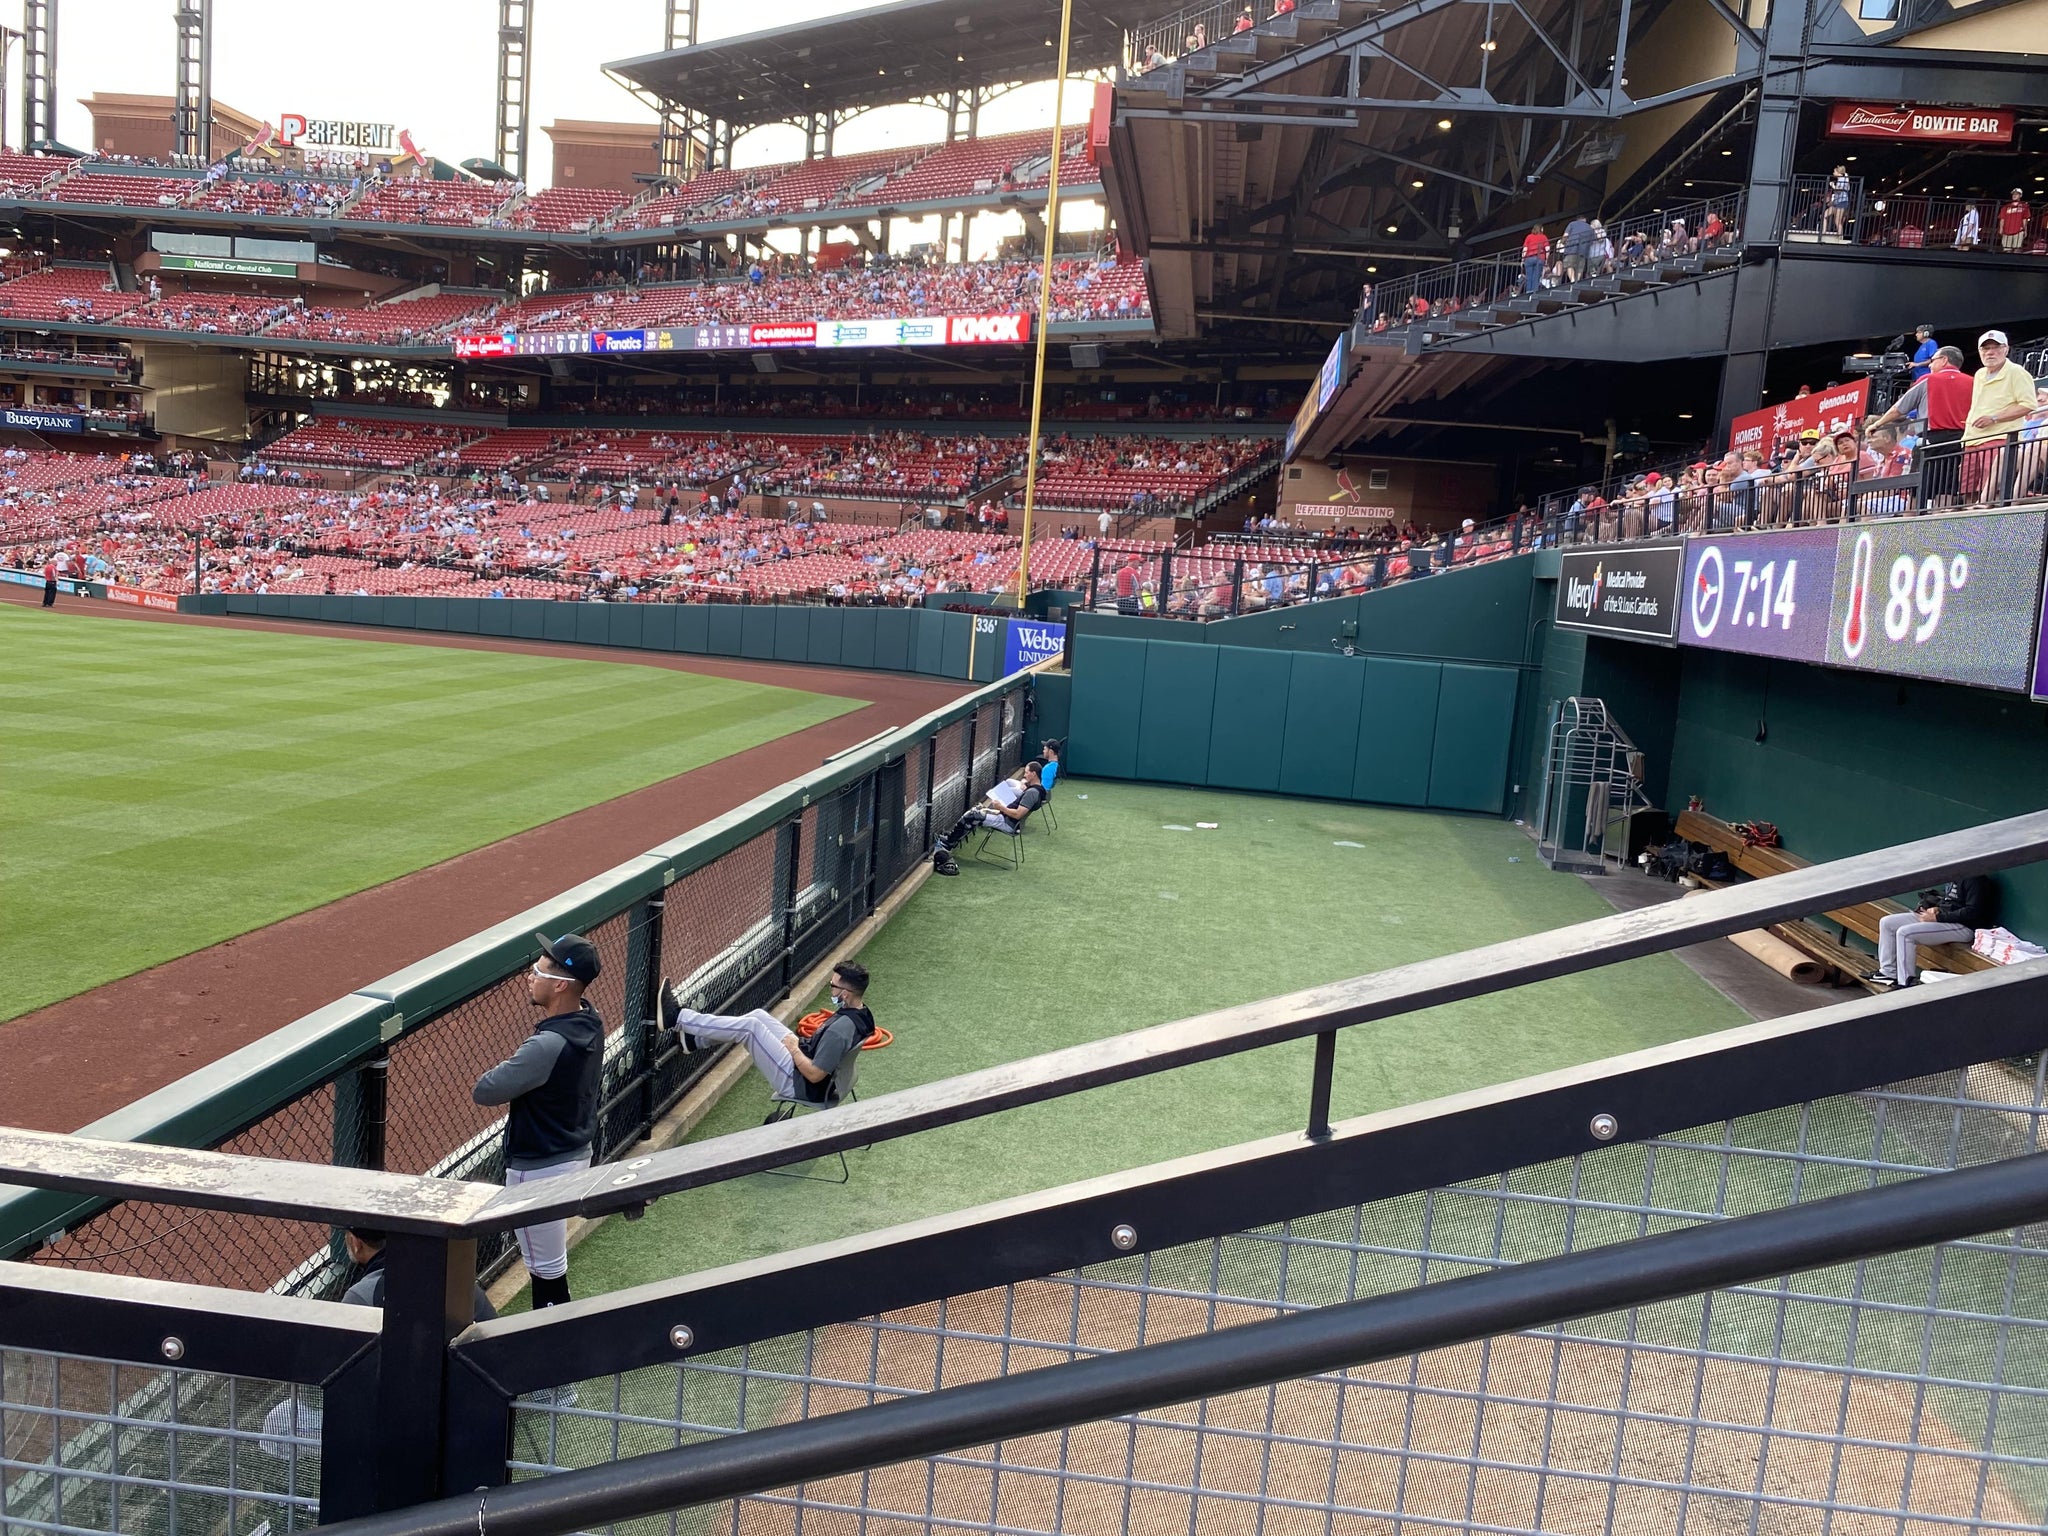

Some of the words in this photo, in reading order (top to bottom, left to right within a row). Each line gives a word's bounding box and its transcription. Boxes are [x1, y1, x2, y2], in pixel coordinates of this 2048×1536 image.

[279, 113, 395, 149] PERFICIENT
[1850, 112, 1905, 126] Budweiser
[1912, 115, 1966, 133] BOWTIE
[1969, 117, 2000, 133] BAR
[303, 150, 371, 167] PERCH
[194, 259, 224, 270] National
[224, 263, 236, 271] Car
[236, 264, 258, 273] Rental
[258, 265, 273, 273] Club
[754, 326, 814, 341] @CARDINALS
[951, 315, 1021, 342] KMOX
[606, 335, 642, 351] Fanatics
[740, 335, 748, 346] 12
[1818, 390, 1860, 413] glennon.org
[1734, 425, 1764, 446] HOMERS
[1295, 503, 1346, 517] LEFTFIELD
[1346, 505, 1395, 518] LANDING
[1606, 571, 1628, 589] Medical
[1627, 571, 1647, 589] Provider
[1566, 576, 1595, 618] Mercy
[1609, 595, 1618, 613] the
[1623, 597, 1635, 614] Louis
[1634, 597, 1659, 616] Cardinals
[1731, 559, 1798, 631] 7:14
[1884, 553, 1969, 644] 89°
[975, 617, 998, 634] 336'
